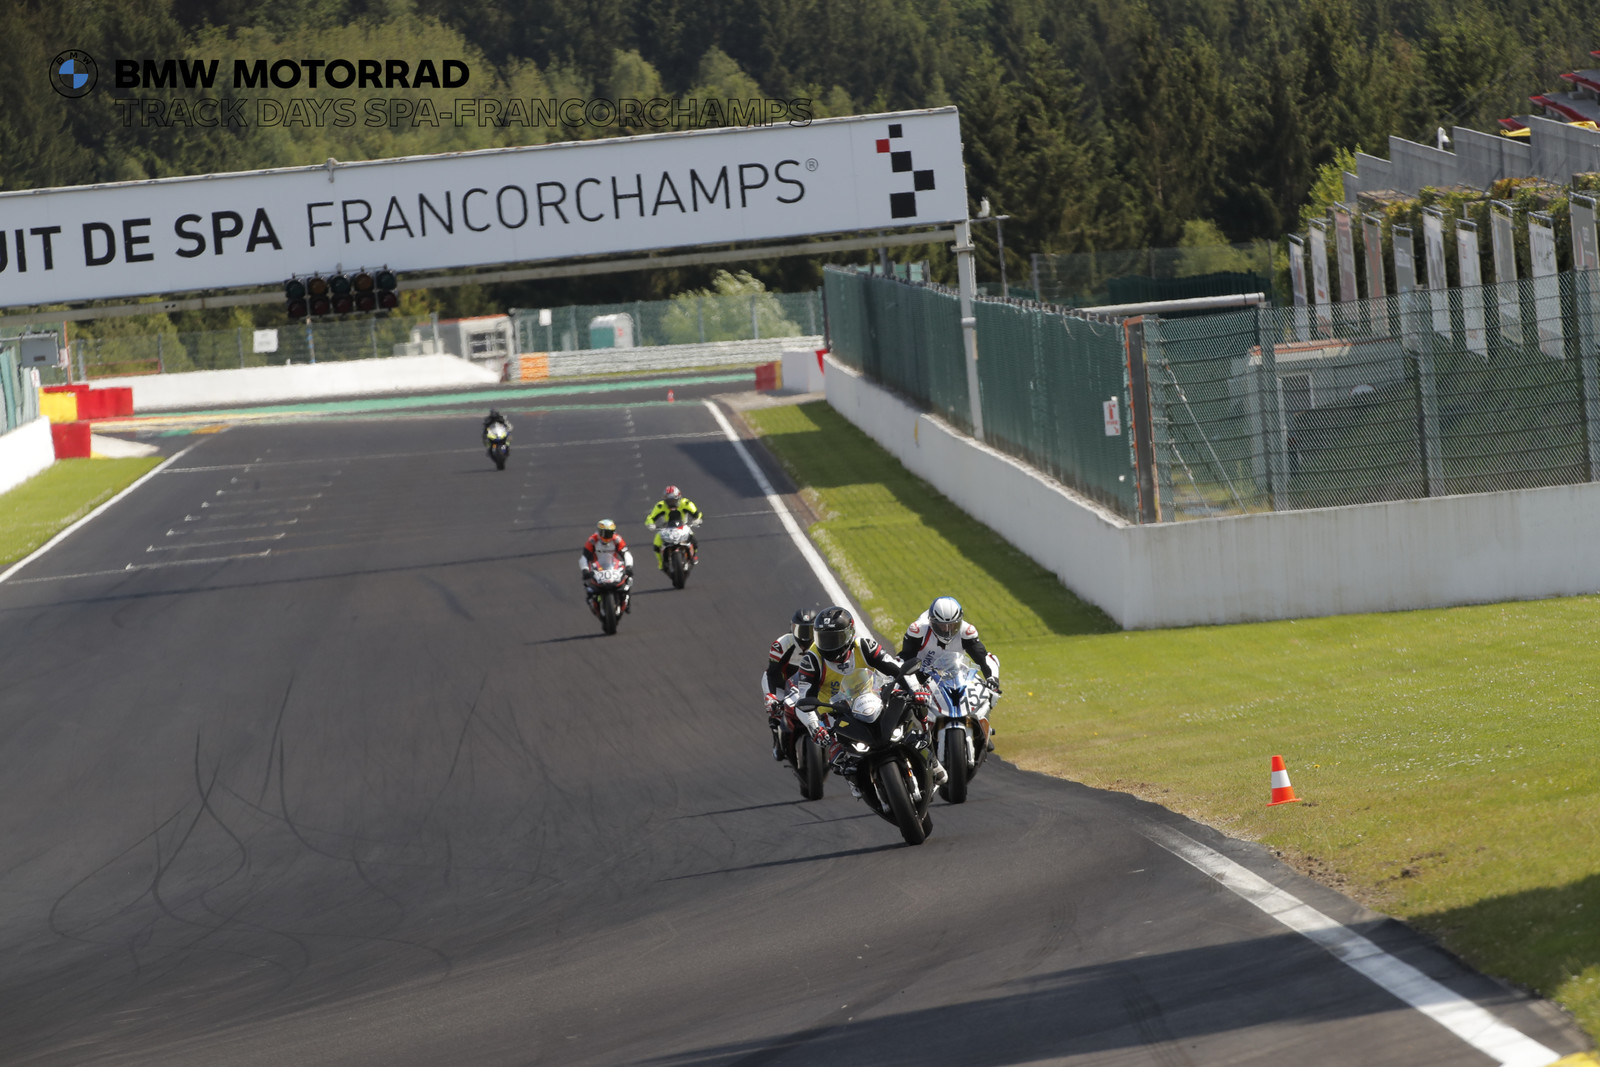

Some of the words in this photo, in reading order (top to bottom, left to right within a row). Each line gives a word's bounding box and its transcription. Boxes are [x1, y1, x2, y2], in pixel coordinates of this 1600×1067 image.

[82, 217, 154, 267] DE
[174, 207, 283, 258] SPA
[960, 681, 989, 713] 152
